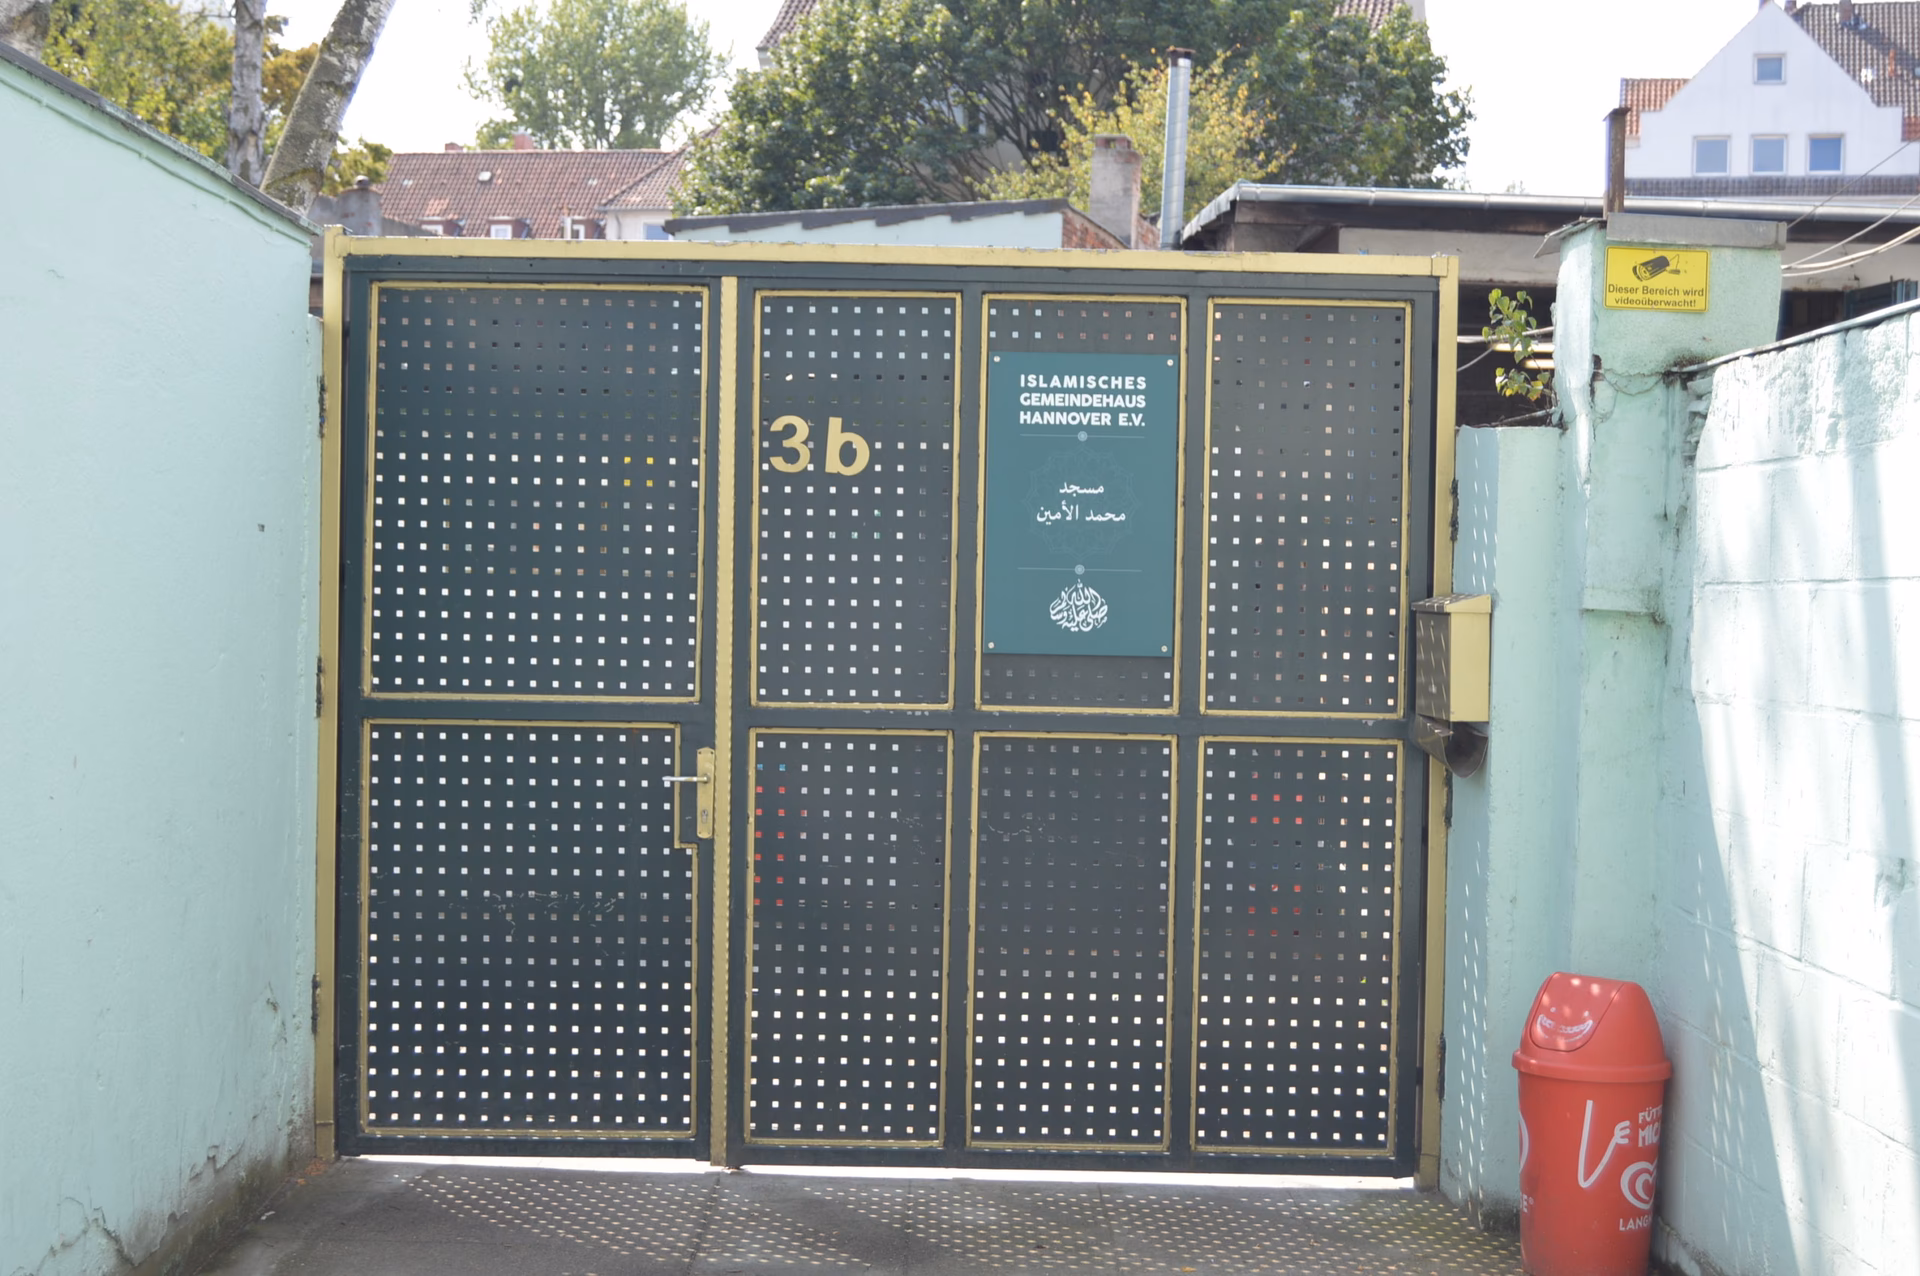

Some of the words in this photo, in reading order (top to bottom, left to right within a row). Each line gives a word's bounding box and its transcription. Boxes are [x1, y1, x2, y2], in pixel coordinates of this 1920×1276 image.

[1608, 284, 1639, 295] Dieser
[1642, 285, 1680, 296] Bereich
[1683, 287, 1704, 297] wird
[1614, 296, 1697, 308] videoüberwacht!
[1020, 374, 1147, 390] ISLAMISCHES
[1019, 392, 1147, 408] GEMEINDEHAUS
[1019, 411, 1112, 426] HANNOVER
[1118, 412, 1146, 427] E.V.
[1059, 481, 1105, 497] مسجد
[1036, 500, 1079, 525] الأمين
[1085, 509, 1126, 522] محمد
[1619, 1213, 1652, 1231] LANG
